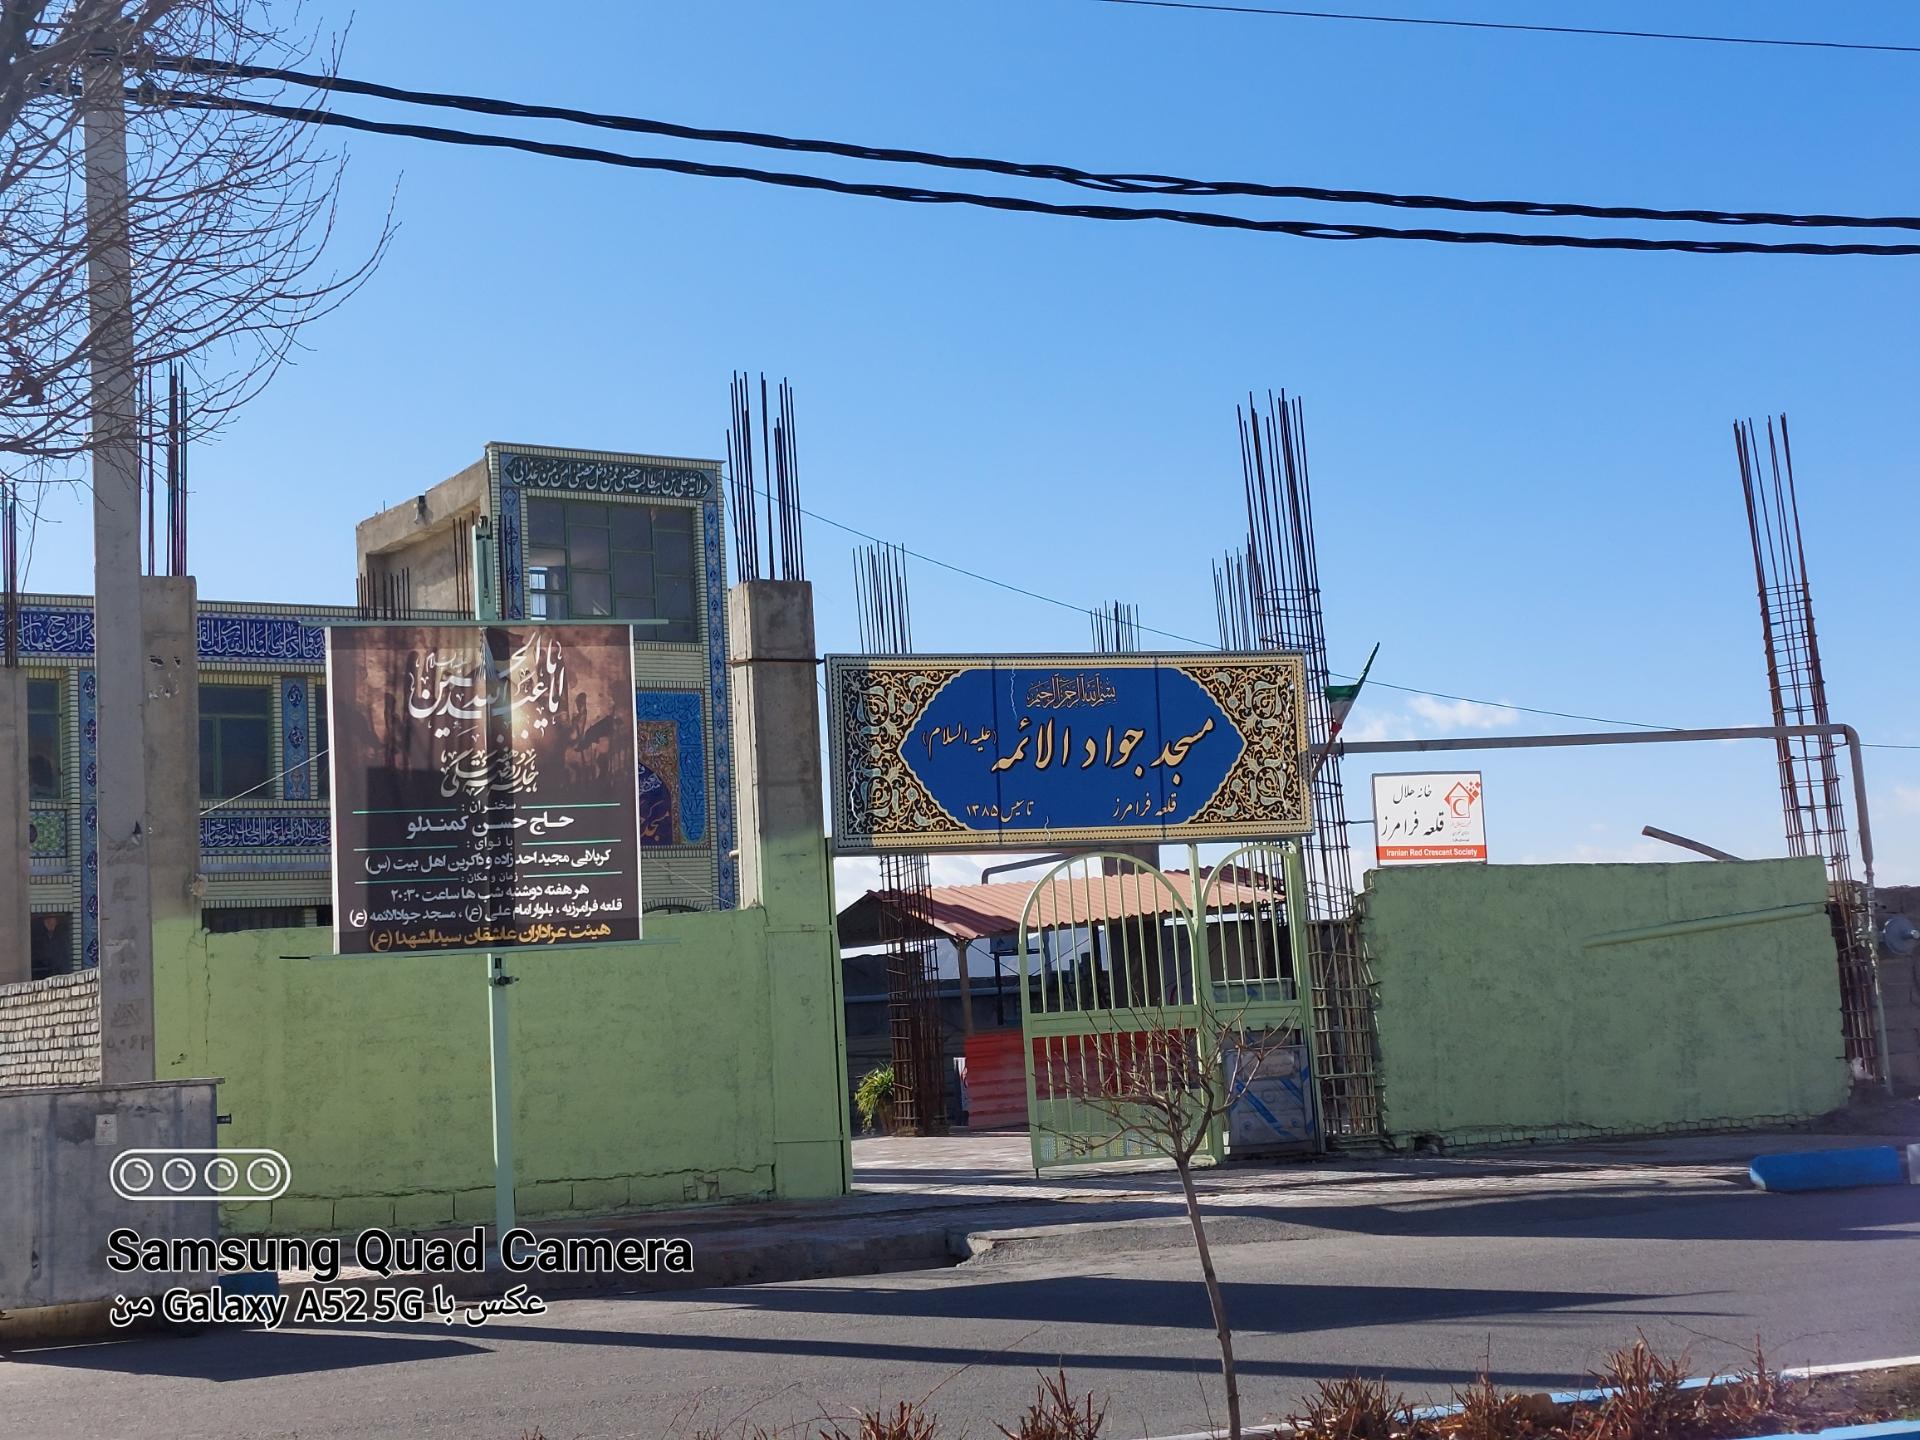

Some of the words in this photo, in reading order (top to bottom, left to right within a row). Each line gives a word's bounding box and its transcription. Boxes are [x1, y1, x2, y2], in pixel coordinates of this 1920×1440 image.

[1081, 726, 1146, 777] جواد
[1150, 717, 1215, 785] مسجد
[469, 799, 516, 814] سخنران
[1111, 791, 1152, 822] فرامرز
[1154, 792, 1178, 818] قلعه
[406, 815, 469, 840] کمندلو
[472, 816, 528, 837] حسن
[529, 811, 575, 836] حاج
[1381, 810, 1419, 840] فرامرز
[1423, 811, 1445, 836] قلعه
[474, 836, 502, 851] نوای
[505, 836, 514, 849] با
[540, 852, 570, 866] مجید
[1386, 848, 1409, 857] Iranian
[1410, 848, 1423, 857] Red
[1453, 847, 1477, 857] Society
[365, 855, 391, 875] (س)
[393, 858, 419, 872] بیت
[420, 855, 446, 873] اهل
[467, 873, 487, 884] مکان
[500, 871, 518, 882] زمان
[391, 888, 420, 902] ۲۰:۳۰
[422, 887, 459, 902] ساعت
[461, 887, 475, 900] ها
[477, 886, 504, 903] شب
[506, 884, 543, 900] دوشنبه
[544, 883, 572, 896] هفته
[572, 884, 590, 900] هر
[465, 904, 483, 922] (ع)
[484, 904, 511, 922] علی
[513, 903, 532, 920] امام
[600, 898, 623, 912] قلعه
[349, 908, 368, 928] (ع)
[422, 908, 456, 922] مسجد
[464, 925, 517, 945] عاشقان
[519, 922, 567, 944] عزاداران
[569, 922, 611, 940] هیئت
[369, 929, 393, 952] (ع)
